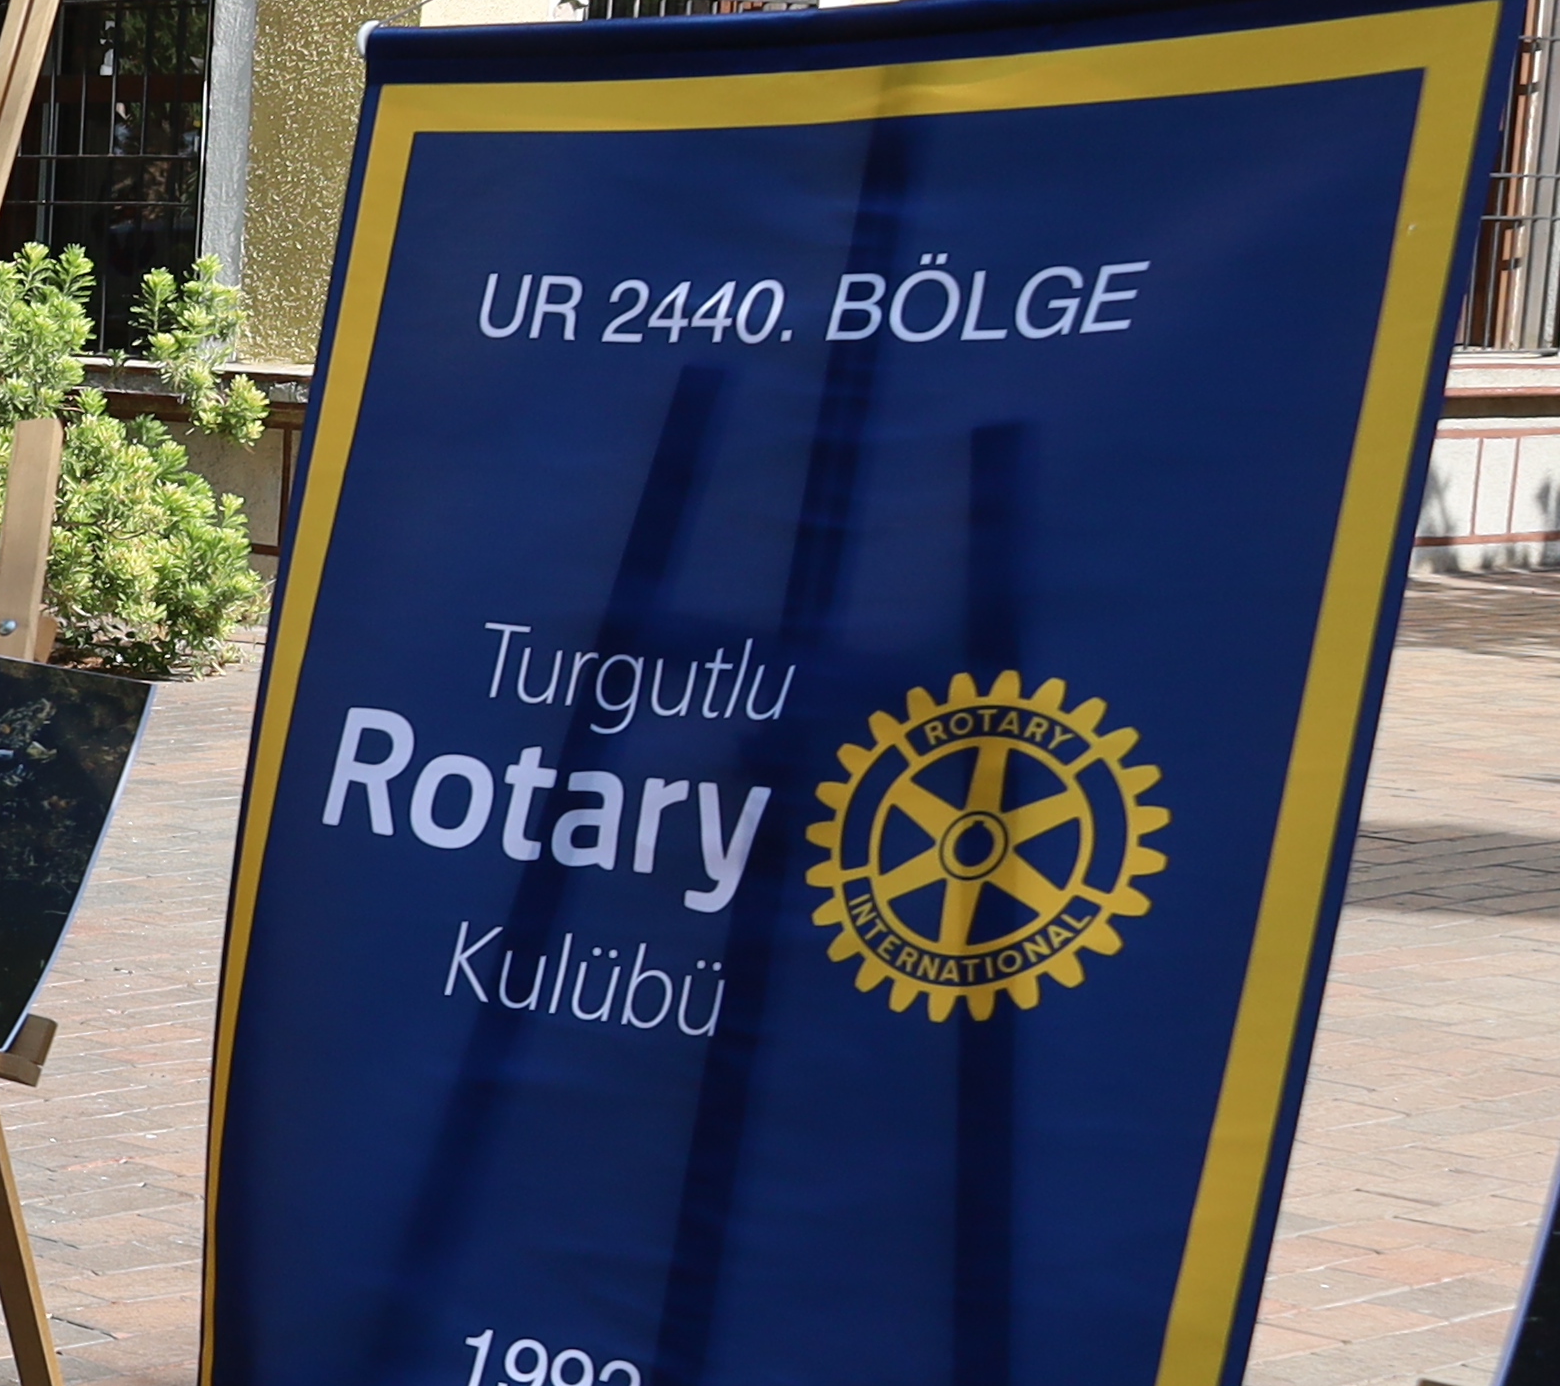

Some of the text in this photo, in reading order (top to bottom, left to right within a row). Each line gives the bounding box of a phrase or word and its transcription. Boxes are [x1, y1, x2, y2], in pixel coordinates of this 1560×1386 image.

[477, 252, 1151, 345] UR 2440. BÖLGE
[485, 621, 796, 734] Turgutlu
[923, 709, 1074, 750] ROTARY
[321, 706, 772, 913] Rotary
[444, 921, 725, 1037] Kulübü
[849, 894, 1092, 983] INTERNATIONAL
